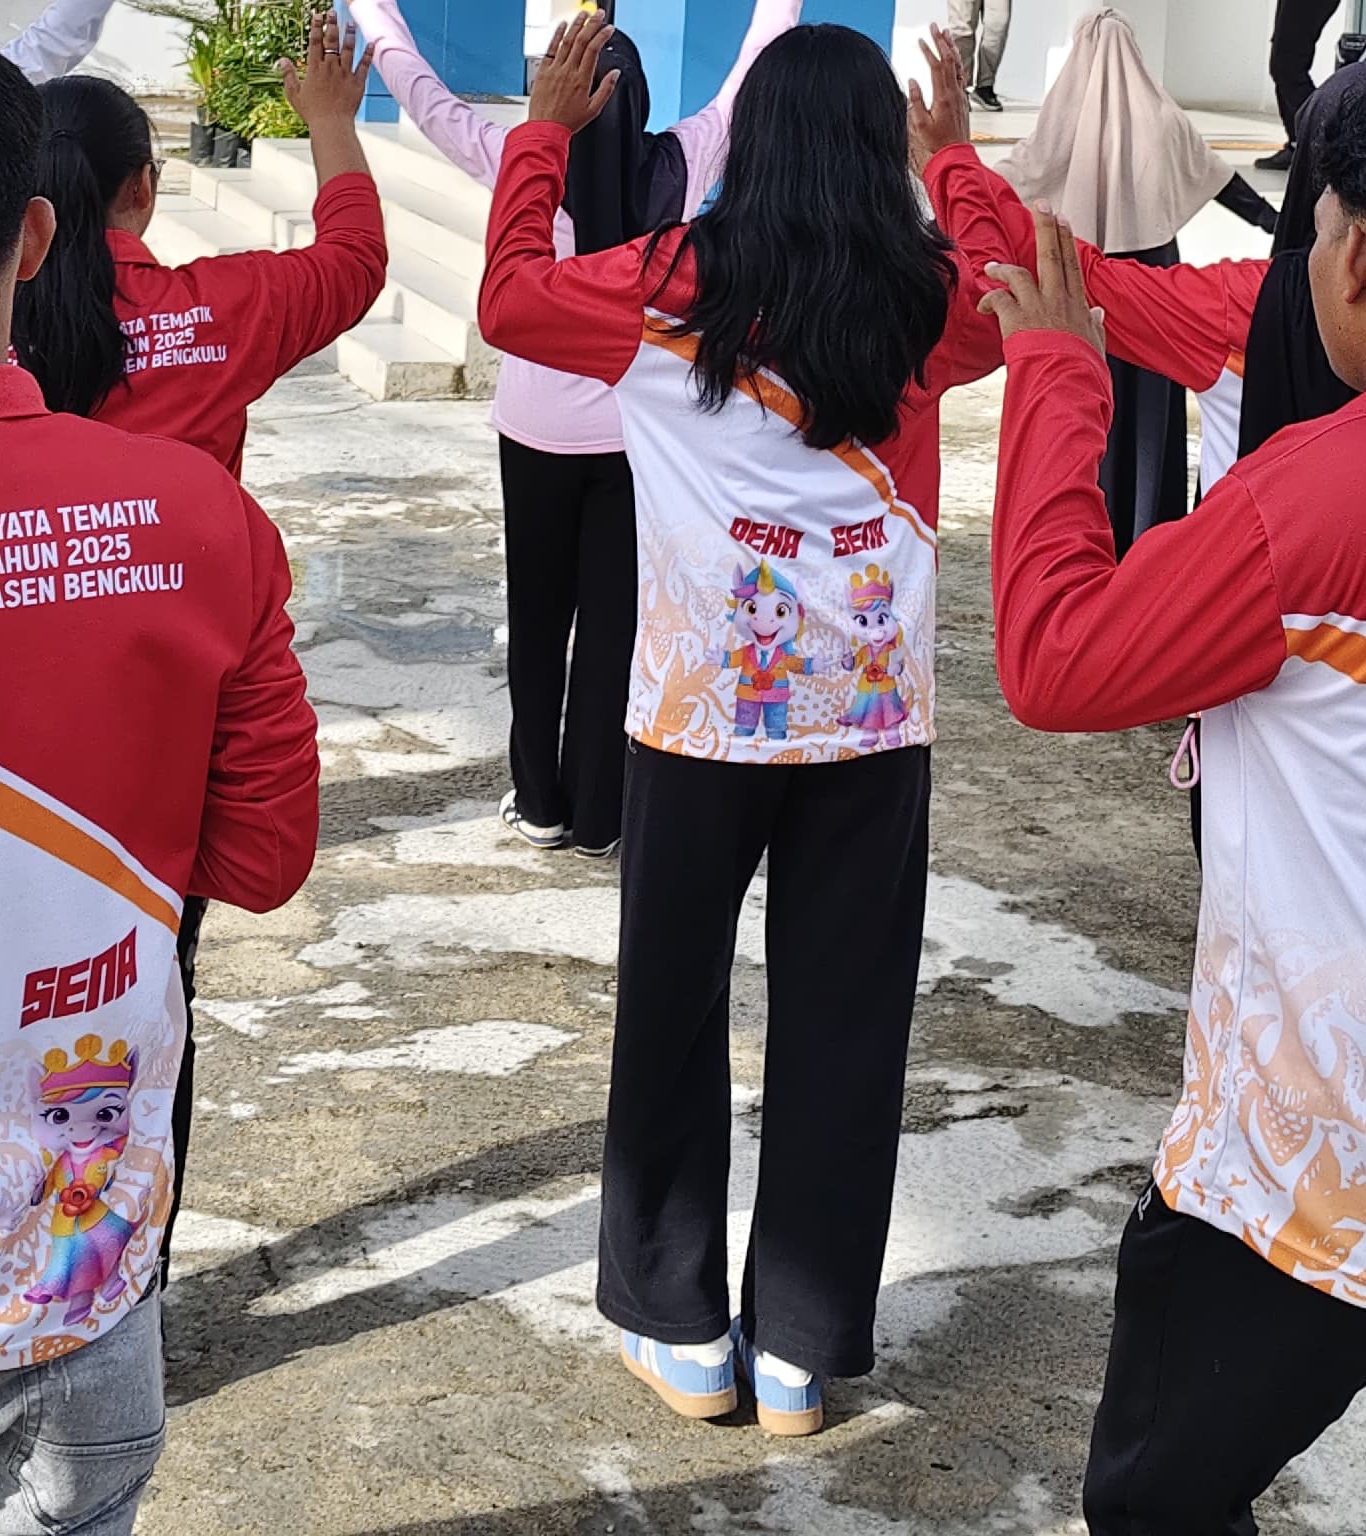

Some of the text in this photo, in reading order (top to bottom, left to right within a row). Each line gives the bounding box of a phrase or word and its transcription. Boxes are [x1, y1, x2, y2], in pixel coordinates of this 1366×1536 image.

[149, 306, 213, 331] TEMATIK
[153, 327, 195, 351] 2025
[151, 345, 227, 368] BENGKULU
[56, 498, 161, 533] TEMATIK
[65, 533, 131, 566] 2025
[729, 516, 888, 559] DEHA SENA
[63, 563, 183, 601] BENGKULU
[20, 926, 137, 1029] SENA
